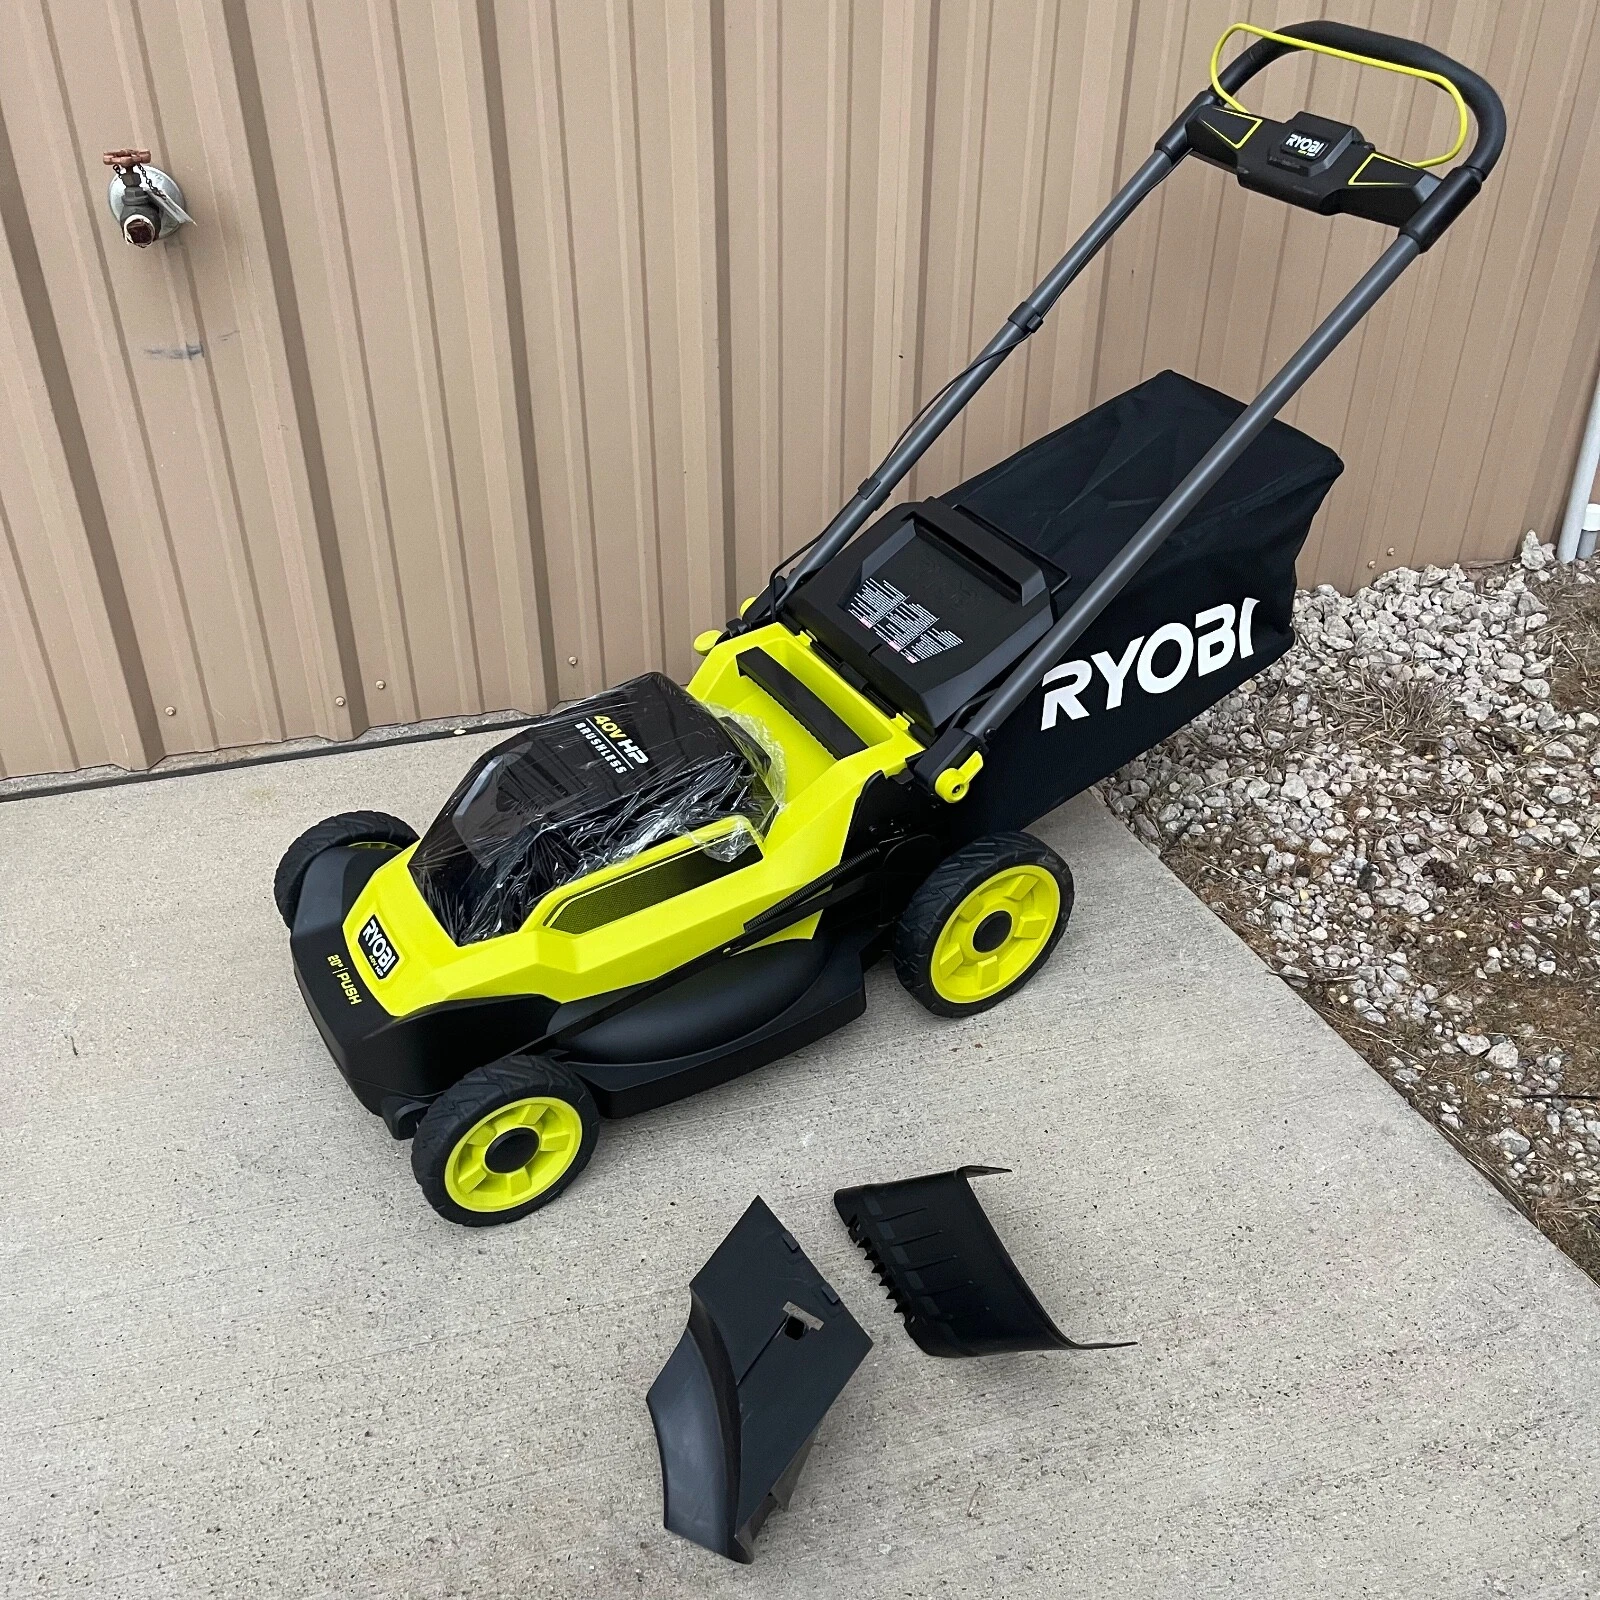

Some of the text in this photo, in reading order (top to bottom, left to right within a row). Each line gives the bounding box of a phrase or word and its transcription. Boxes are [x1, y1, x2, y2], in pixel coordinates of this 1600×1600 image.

[1285, 133, 1325, 154] RYOBI
[1040, 597, 1261, 732] RYOBI
[574, 722, 628, 774] BRUSHLESS
[362, 918, 397, 973] RYOBI
[336, 971, 363, 1005] PUSH
